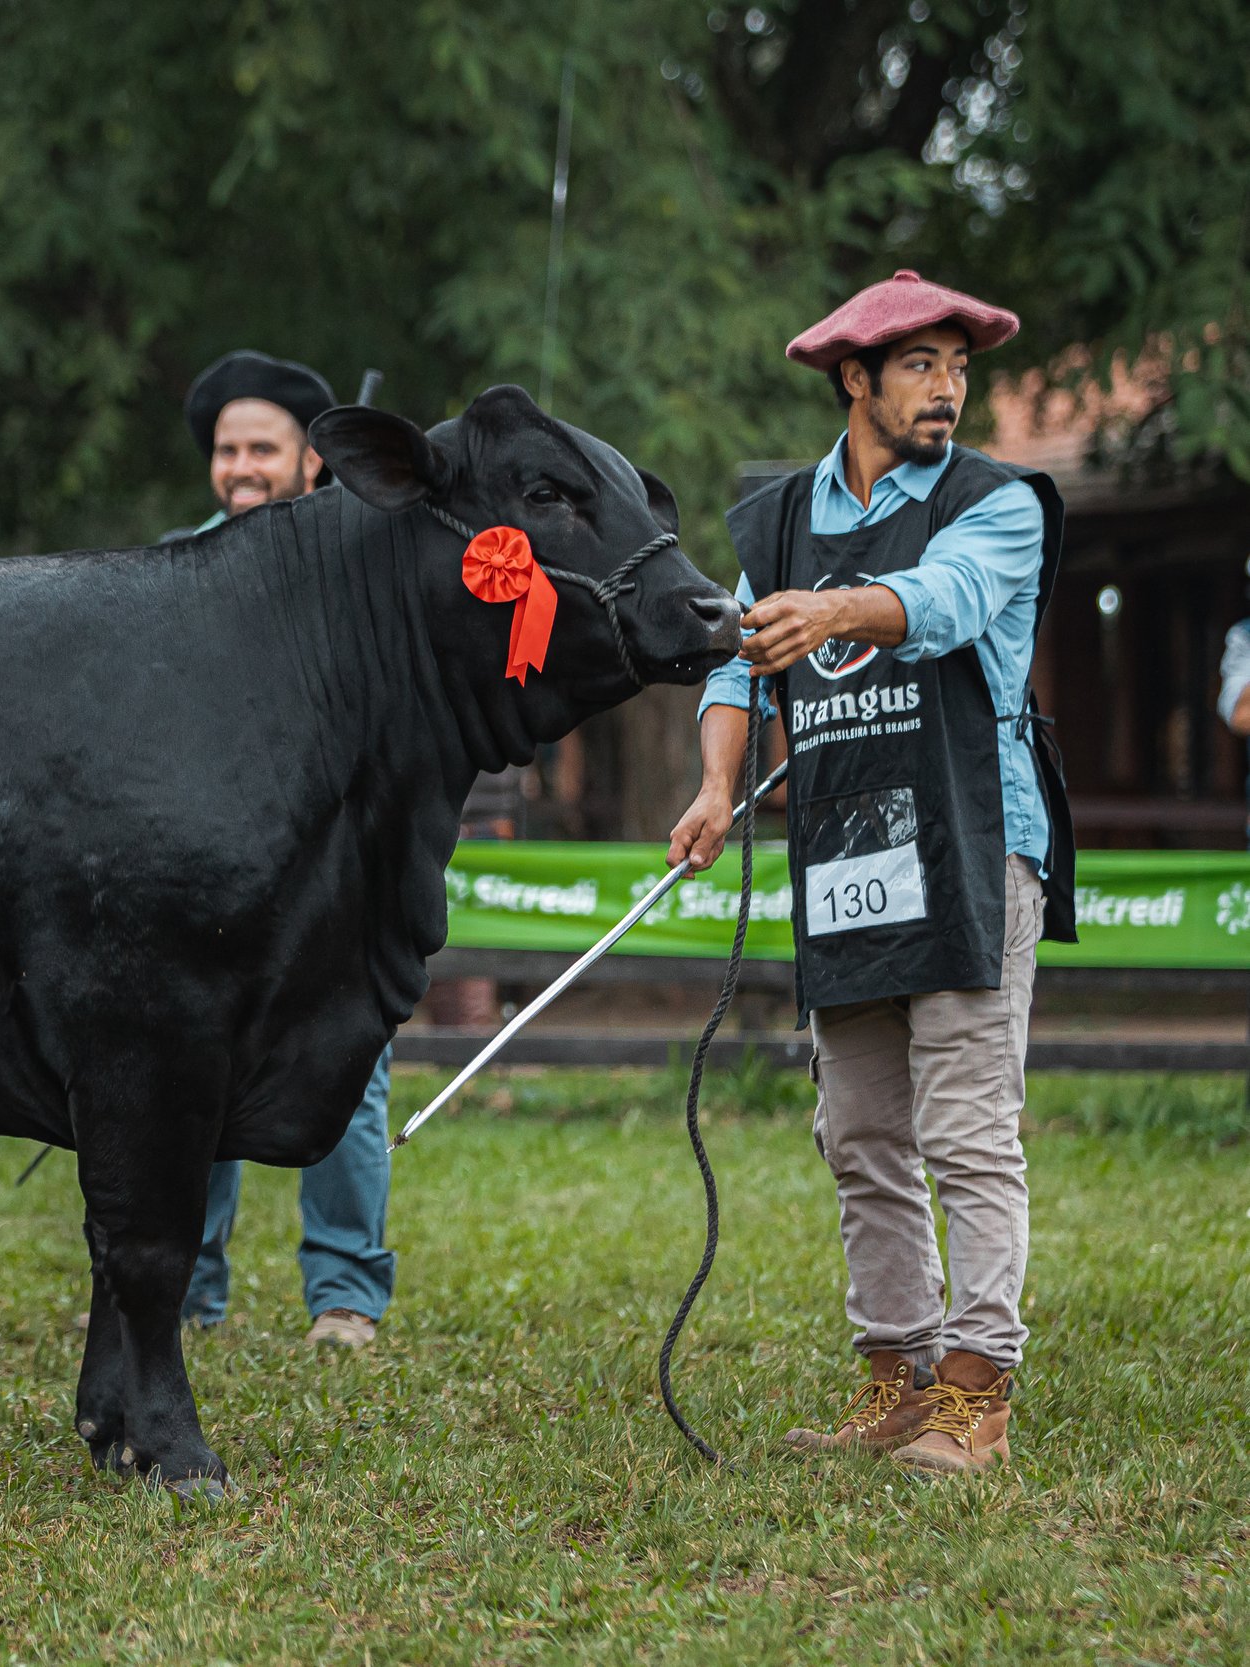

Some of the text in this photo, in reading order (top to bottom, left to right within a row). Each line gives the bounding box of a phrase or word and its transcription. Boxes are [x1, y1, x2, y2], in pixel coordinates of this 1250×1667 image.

[792, 682, 920, 735] Brangus
[819, 725, 868, 744] BRASILEIRA
[870, 723, 882, 736] DE
[678, 881, 792, 921] Sicred
[823, 878, 887, 923] 130
